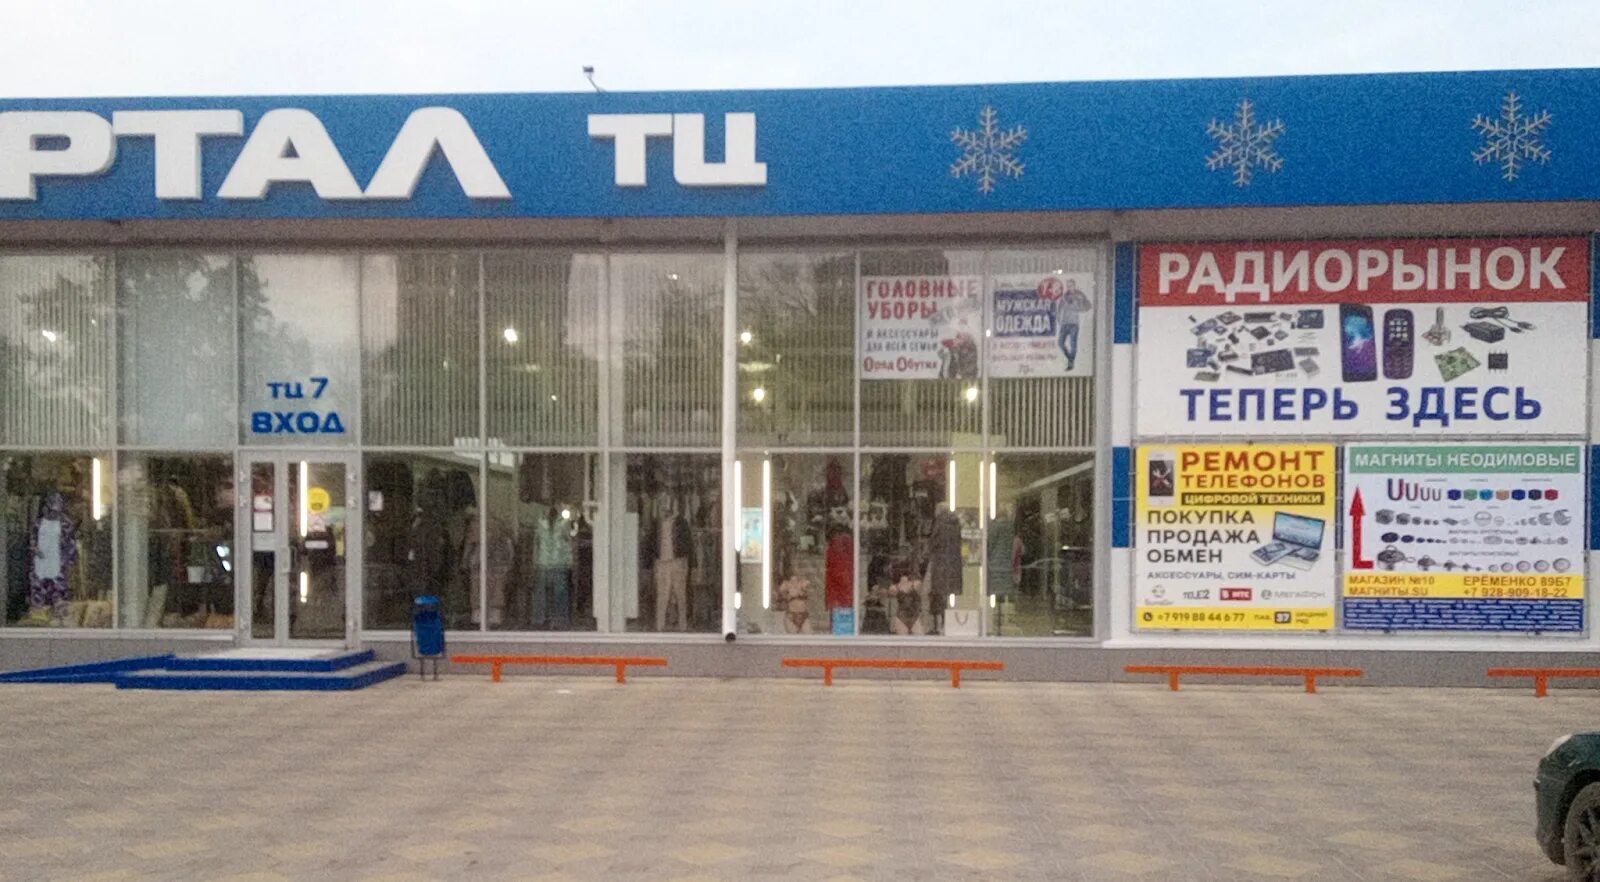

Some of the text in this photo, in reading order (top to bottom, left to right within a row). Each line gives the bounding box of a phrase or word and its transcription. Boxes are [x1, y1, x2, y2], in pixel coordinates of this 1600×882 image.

[588, 112, 767, 187] ТЦ
[1158, 246, 1567, 302] РАДИОРЫНОК
[867, 279, 978, 298] ГОЛОВНЫЕ
[867, 301, 938, 319] УБОРЫ
[996, 314, 1051, 333] ОДЕЖДА
[310, 376, 328, 398] 7
[1180, 386, 1542, 427] ТЕПЕРЬ ЗДЕСЬ
[251, 411, 344, 433] ВХОД
[1181, 450, 1325, 471] РЕМОНТ
[1355, 453, 1576, 467] МАГНИТЫ НЕОДИМОВЫЕ
[1181, 474, 1325, 488] ТЕЛЕФОНОВ
[1184, 493, 1322, 505] ЦИФРОВОЙ ТЕХНИКИ
[1147, 510, 1255, 524] ПОКУПКА
[1147, 529, 1260, 546] ПРОДАЖА
[1147, 549, 1222, 563] ОБМЕН
[1147, 570, 1296, 581] АКСЕССУАРЫ, СИМ-КАРТЫ
[1349, 576, 1435, 585] МАГАЗИН №10
[1349, 586, 1428, 596] МАГНИТЫ.SU
[1464, 587, 1568, 597] +7 928-909-18-22
[1158, 612, 1170, 621] +7
[1172, 612, 1190, 621] 919
[1192, 612, 1206, 621] 88
[1208, 612, 1222, 621] 44
[1224, 613, 1231, 621] 6
[1233, 612, 1245, 621] 77
